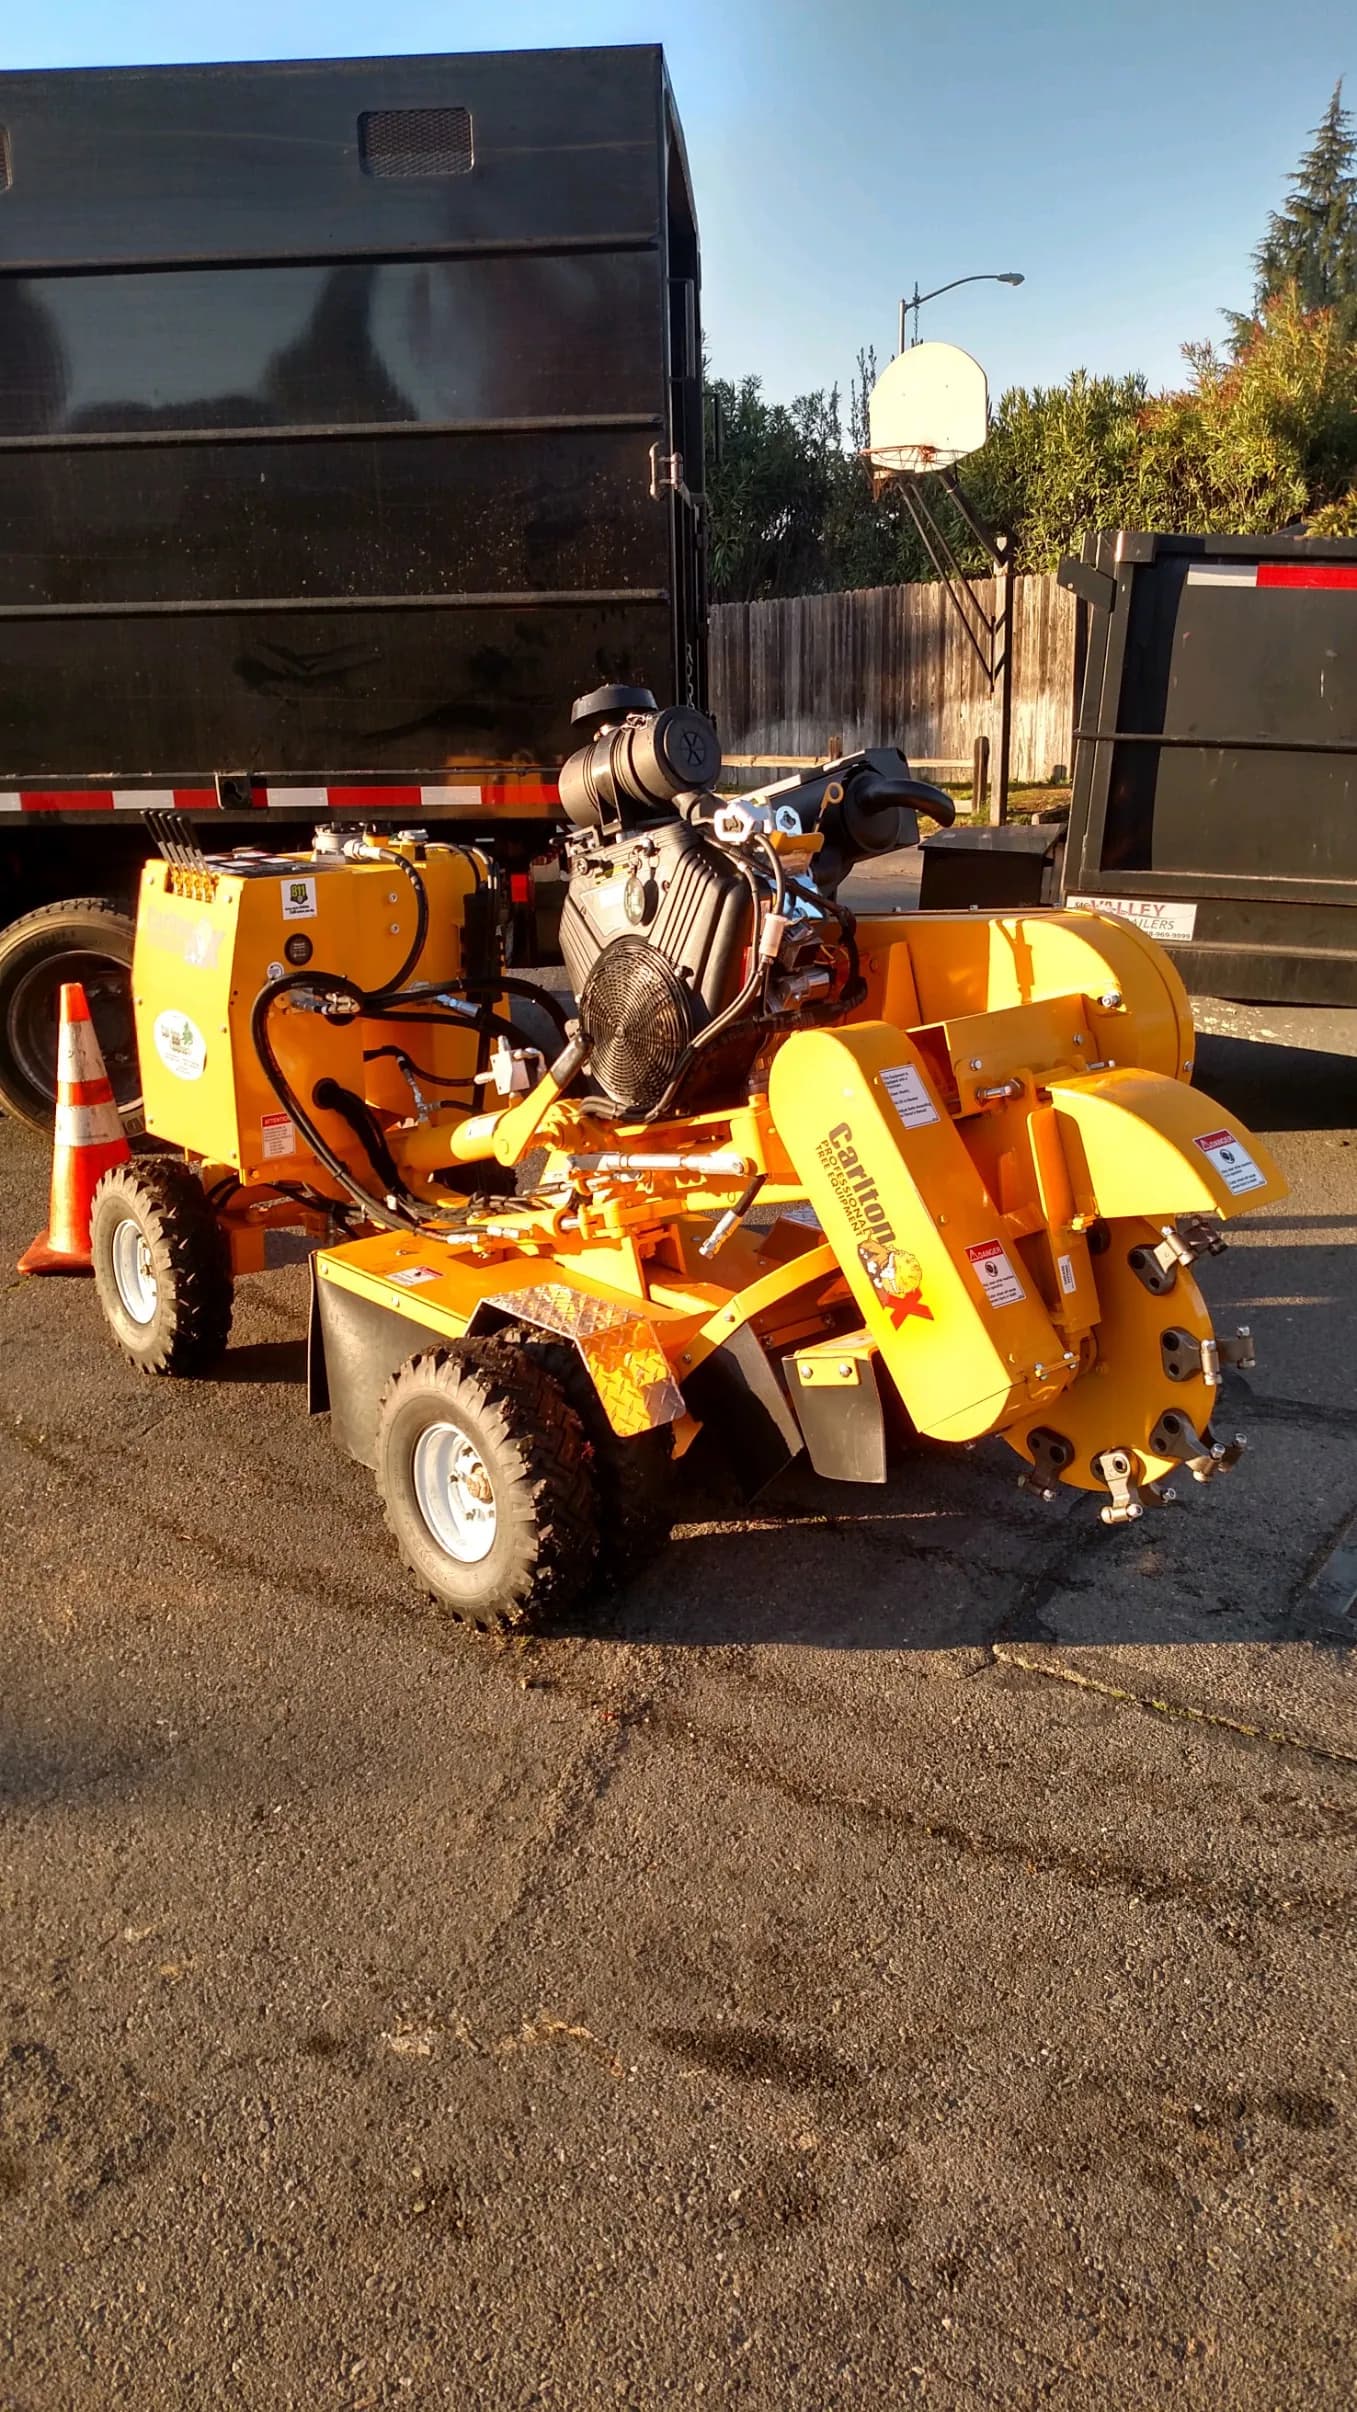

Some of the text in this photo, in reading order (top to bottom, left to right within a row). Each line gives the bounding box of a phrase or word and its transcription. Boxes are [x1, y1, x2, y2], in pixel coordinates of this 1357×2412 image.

[1091, 899, 1166, 916] VALLEY
[1209, 1135, 1233, 1147] DANGER
[815, 1145, 865, 1237] TREE EQUIPMENT
[820, 1139, 873, 1236] PROFESSIONAL
[829, 1122, 896, 1246] Carlton
[977, 1246, 1002, 1260] DANGER
